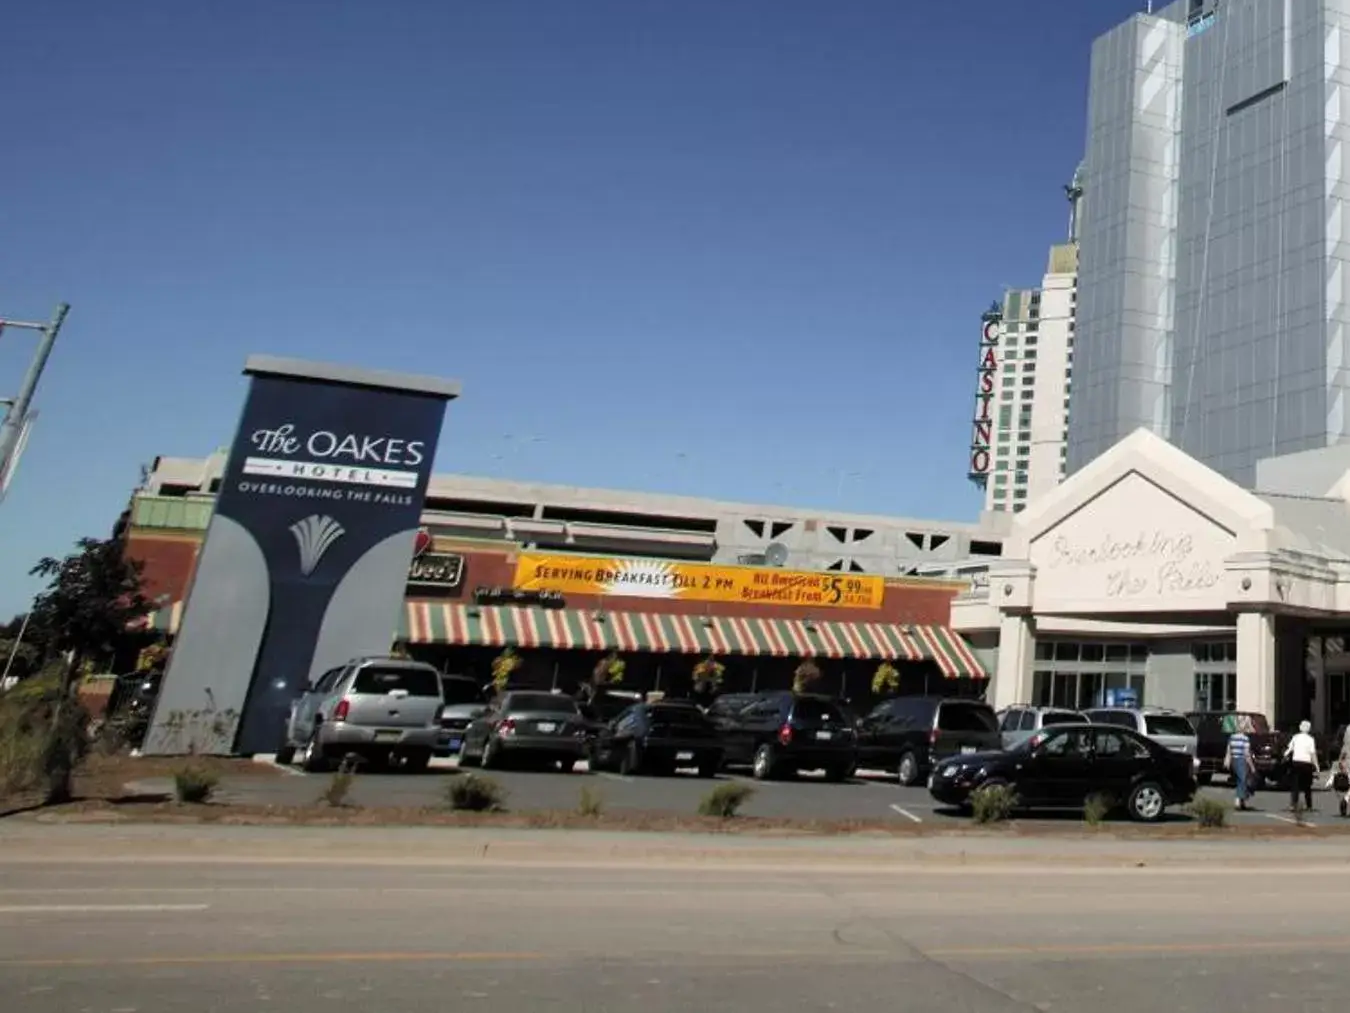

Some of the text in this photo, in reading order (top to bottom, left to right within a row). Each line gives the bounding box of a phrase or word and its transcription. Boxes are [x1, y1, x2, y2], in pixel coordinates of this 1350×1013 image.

[973, 320, 1000, 472] CASINO
[251, 423, 425, 465] The OAKES
[293, 464, 372, 481] HOTEL
[238, 482, 413, 506] OVERLOOKING THE FALLS
[1049, 529, 1194, 569] Overlooking
[534, 564, 592, 582] SERVING
[595, 568, 668, 585] BREAKFAST
[672, 573, 697, 588] TILL
[702, 575, 711, 589] 2
